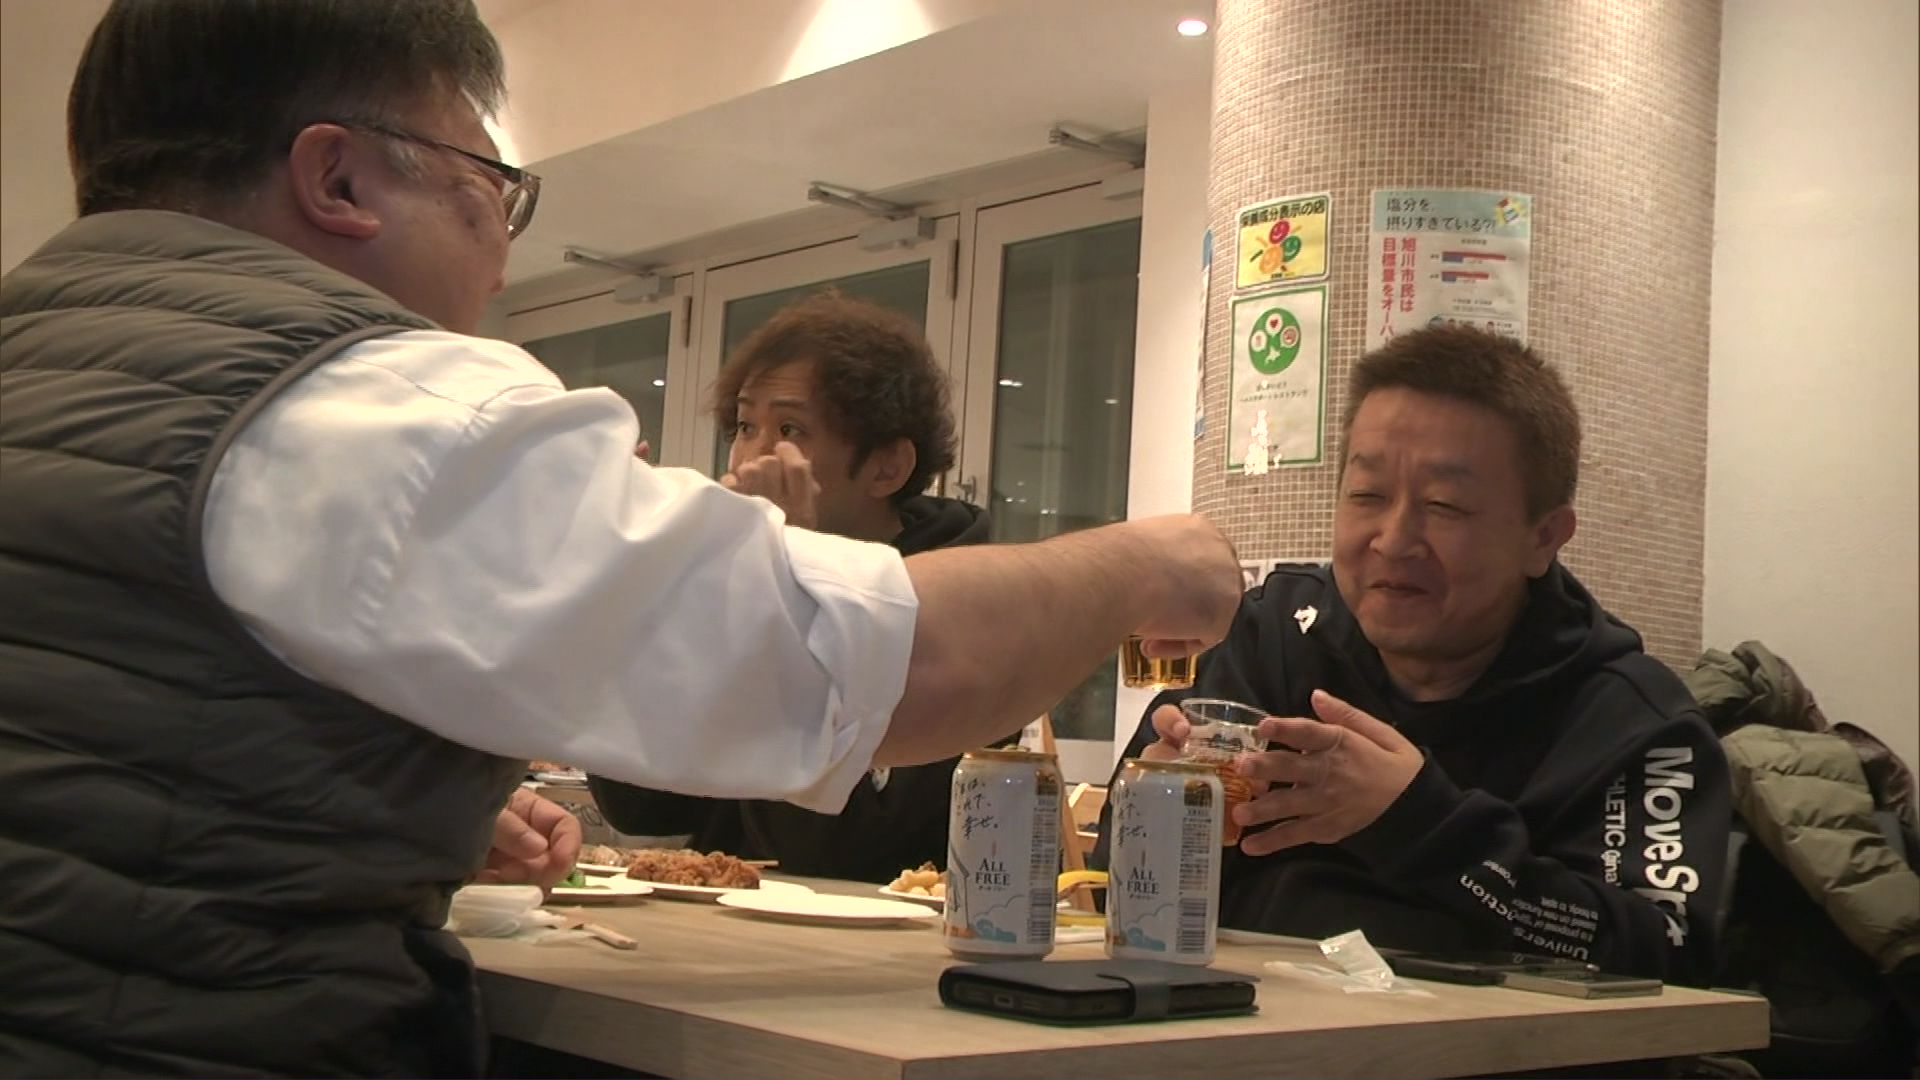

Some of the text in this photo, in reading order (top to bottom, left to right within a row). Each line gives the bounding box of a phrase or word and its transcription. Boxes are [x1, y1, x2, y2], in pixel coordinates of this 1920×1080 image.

[1400, 237, 1417, 312] 旭川市民は
[979, 858, 1006, 872] ALL
[975, 872, 1011, 886] FREE
[1130, 867, 1156, 881] ALL
[1126, 880, 1160, 895] FREE
